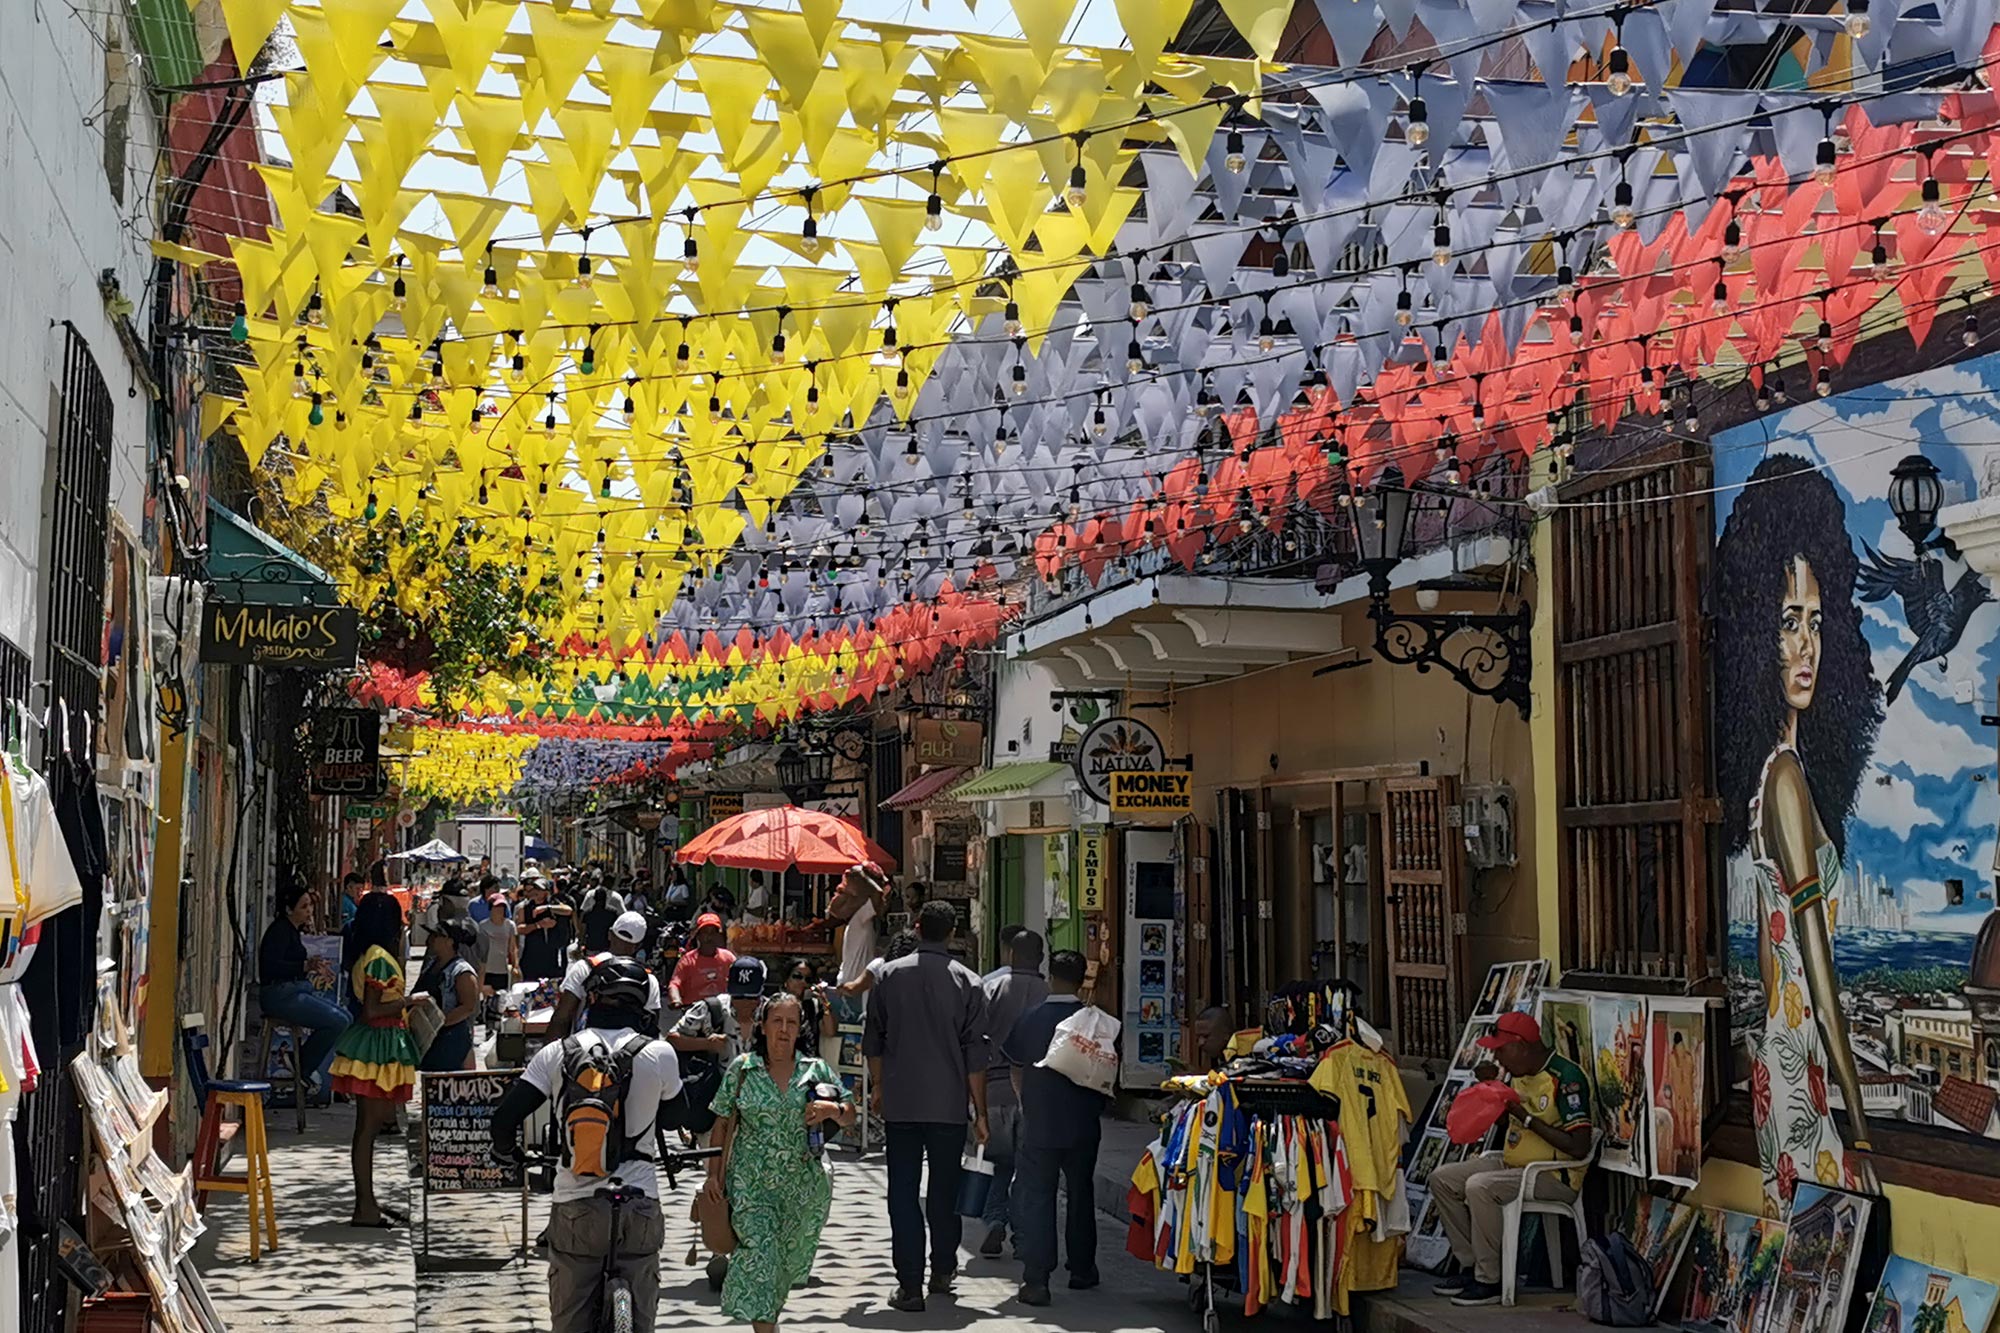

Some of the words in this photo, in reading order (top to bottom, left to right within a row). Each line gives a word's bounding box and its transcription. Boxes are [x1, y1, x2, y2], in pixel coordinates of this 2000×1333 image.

[325, 748, 364, 764] BEER
[315, 764, 374, 779] LOVERS
[1092, 757, 1153, 771] NATIVA
[1116, 775, 1188, 792] MONEY
[1116, 795, 1190, 807] EXCHANGE
[350, 807, 371, 817] ATM
[1085, 840, 1098, 906] CAMBIOS
[1358, 1084, 1376, 1120] 7
